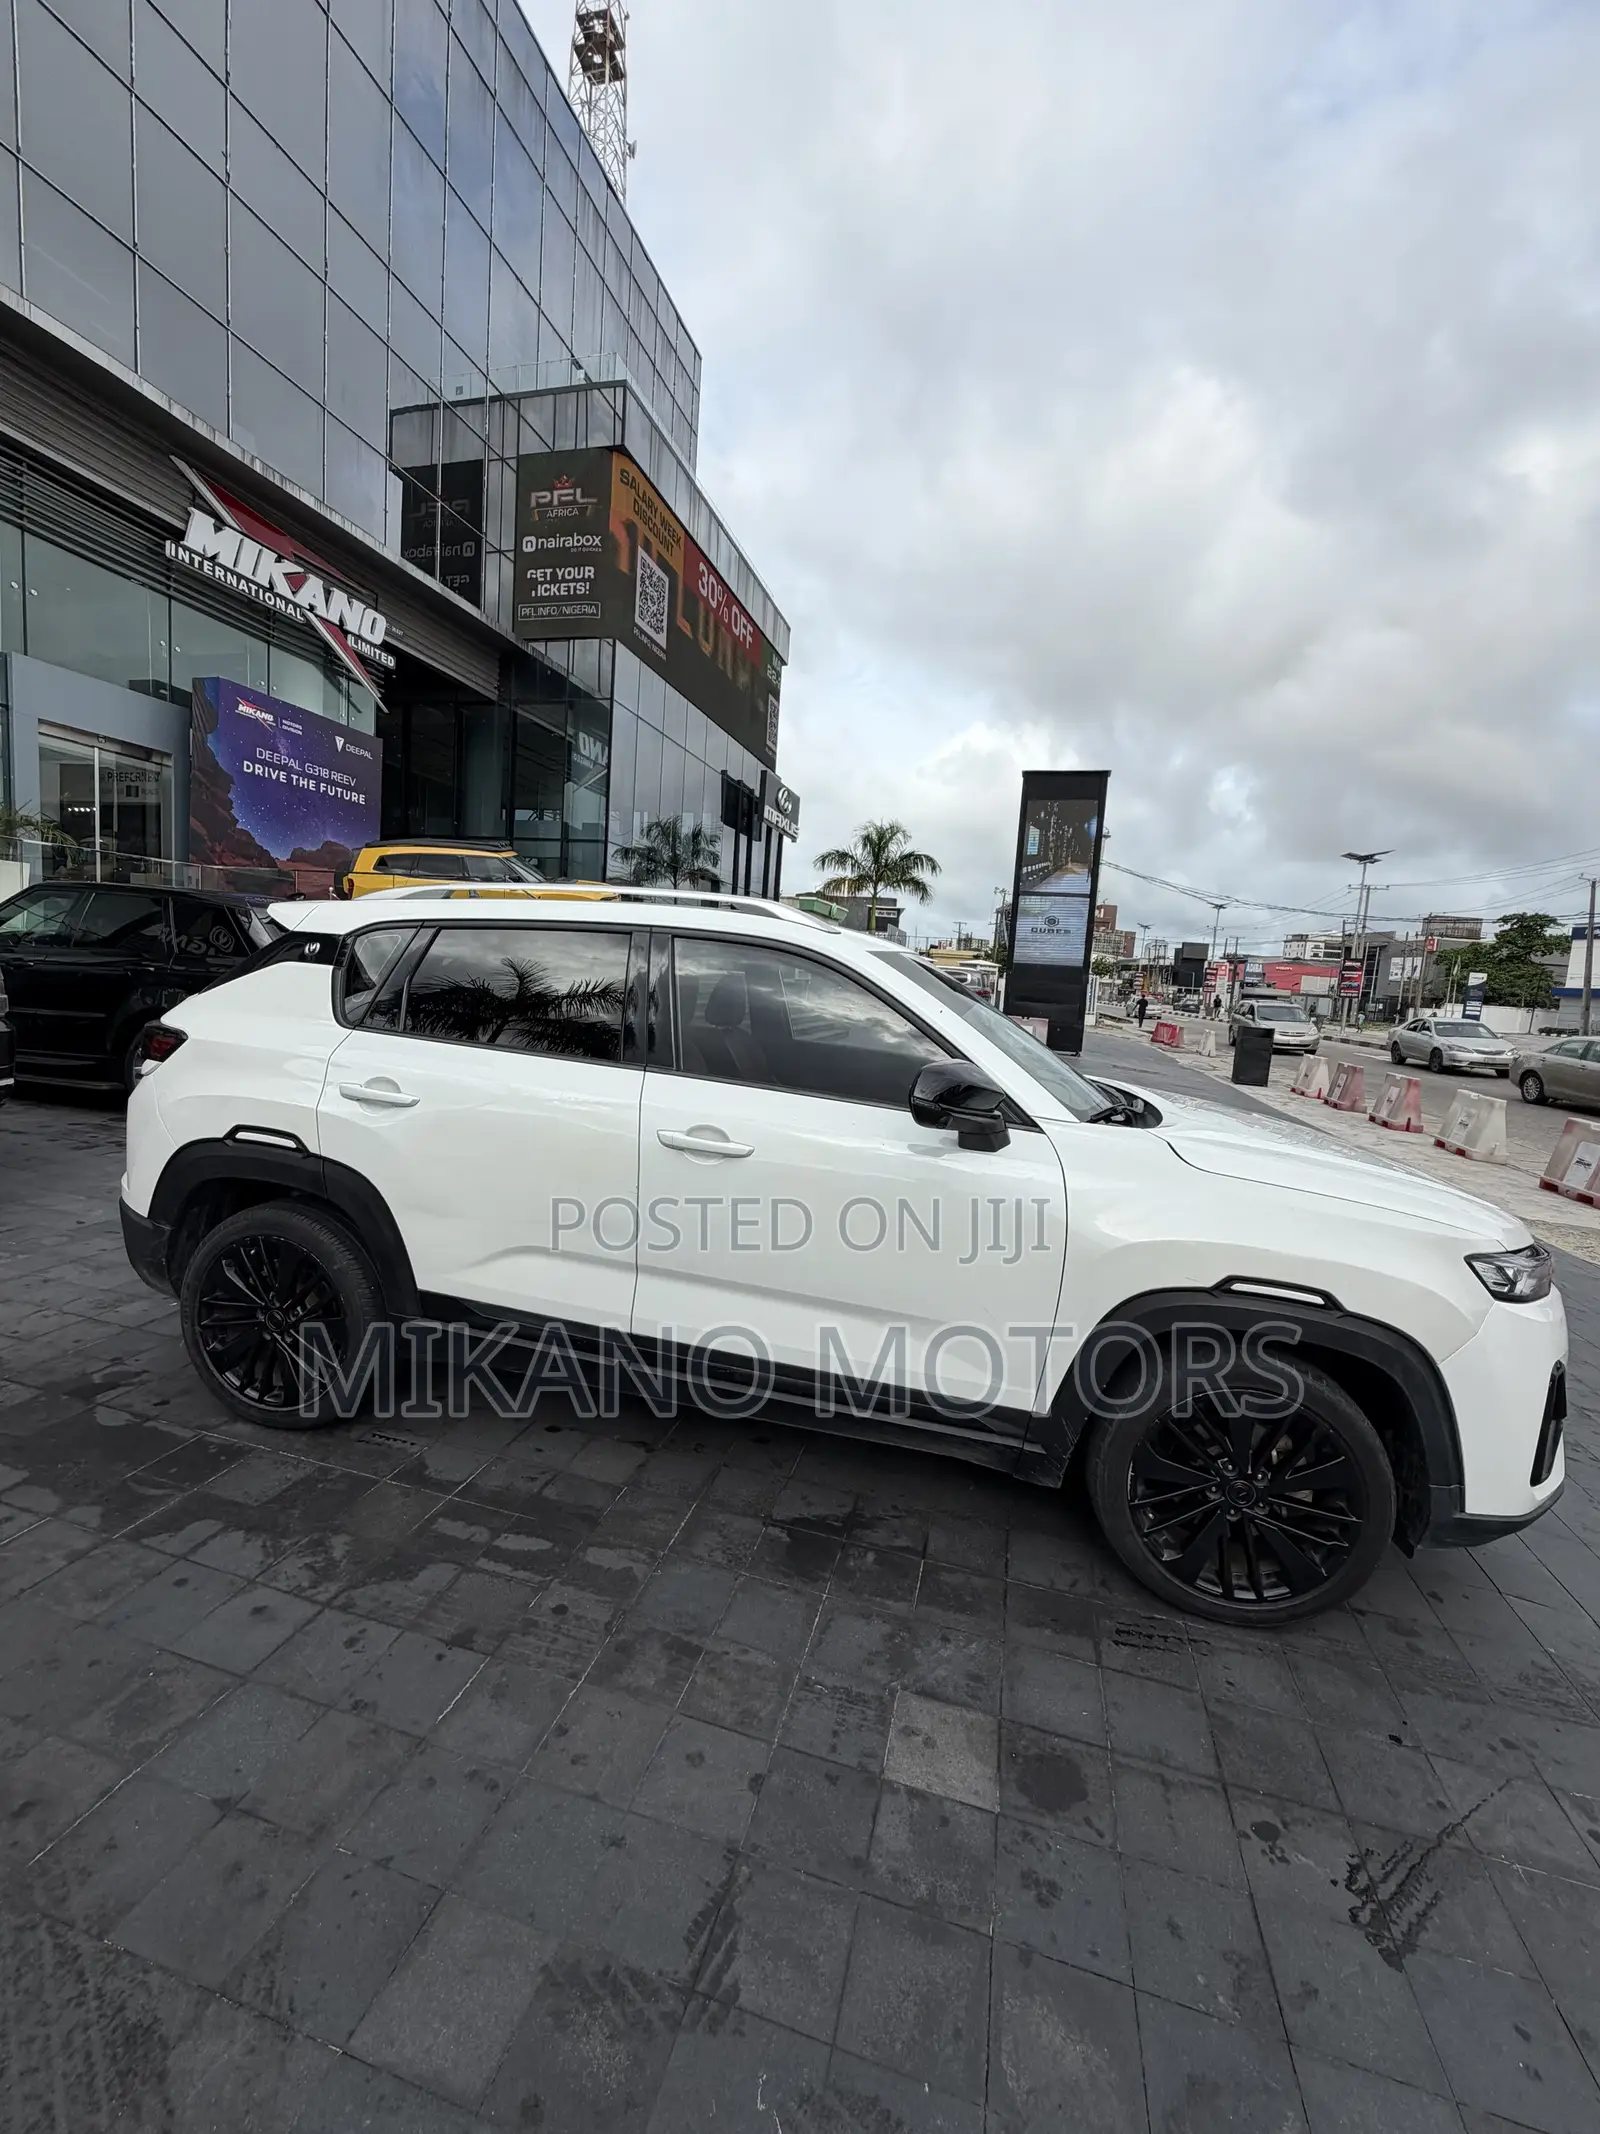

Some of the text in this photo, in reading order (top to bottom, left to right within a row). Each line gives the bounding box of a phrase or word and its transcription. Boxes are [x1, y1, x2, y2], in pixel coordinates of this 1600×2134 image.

[530, 488, 599, 508] PFL
[547, 507, 579, 518] AFRICA
[620, 467, 682, 551] SALARY WEEK
[538, 532, 602, 549] nairabox
[633, 497, 675, 557] DISCOUNT
[170, 542, 306, 622] INTERNATIONAL
[180, 507, 387, 646] MIKANO
[556, 566, 595, 580] YOUR
[698, 561, 754, 649] 30% OFF
[351, 637, 396, 668] LIMITED
[256, 747, 357, 787] DEEPAL G318 REEV
[345, 743, 373, 760] DEEPAL
[243, 760, 366, 805] DRIVE THE FUTURE
[764, 804, 800, 839] MAXUS
